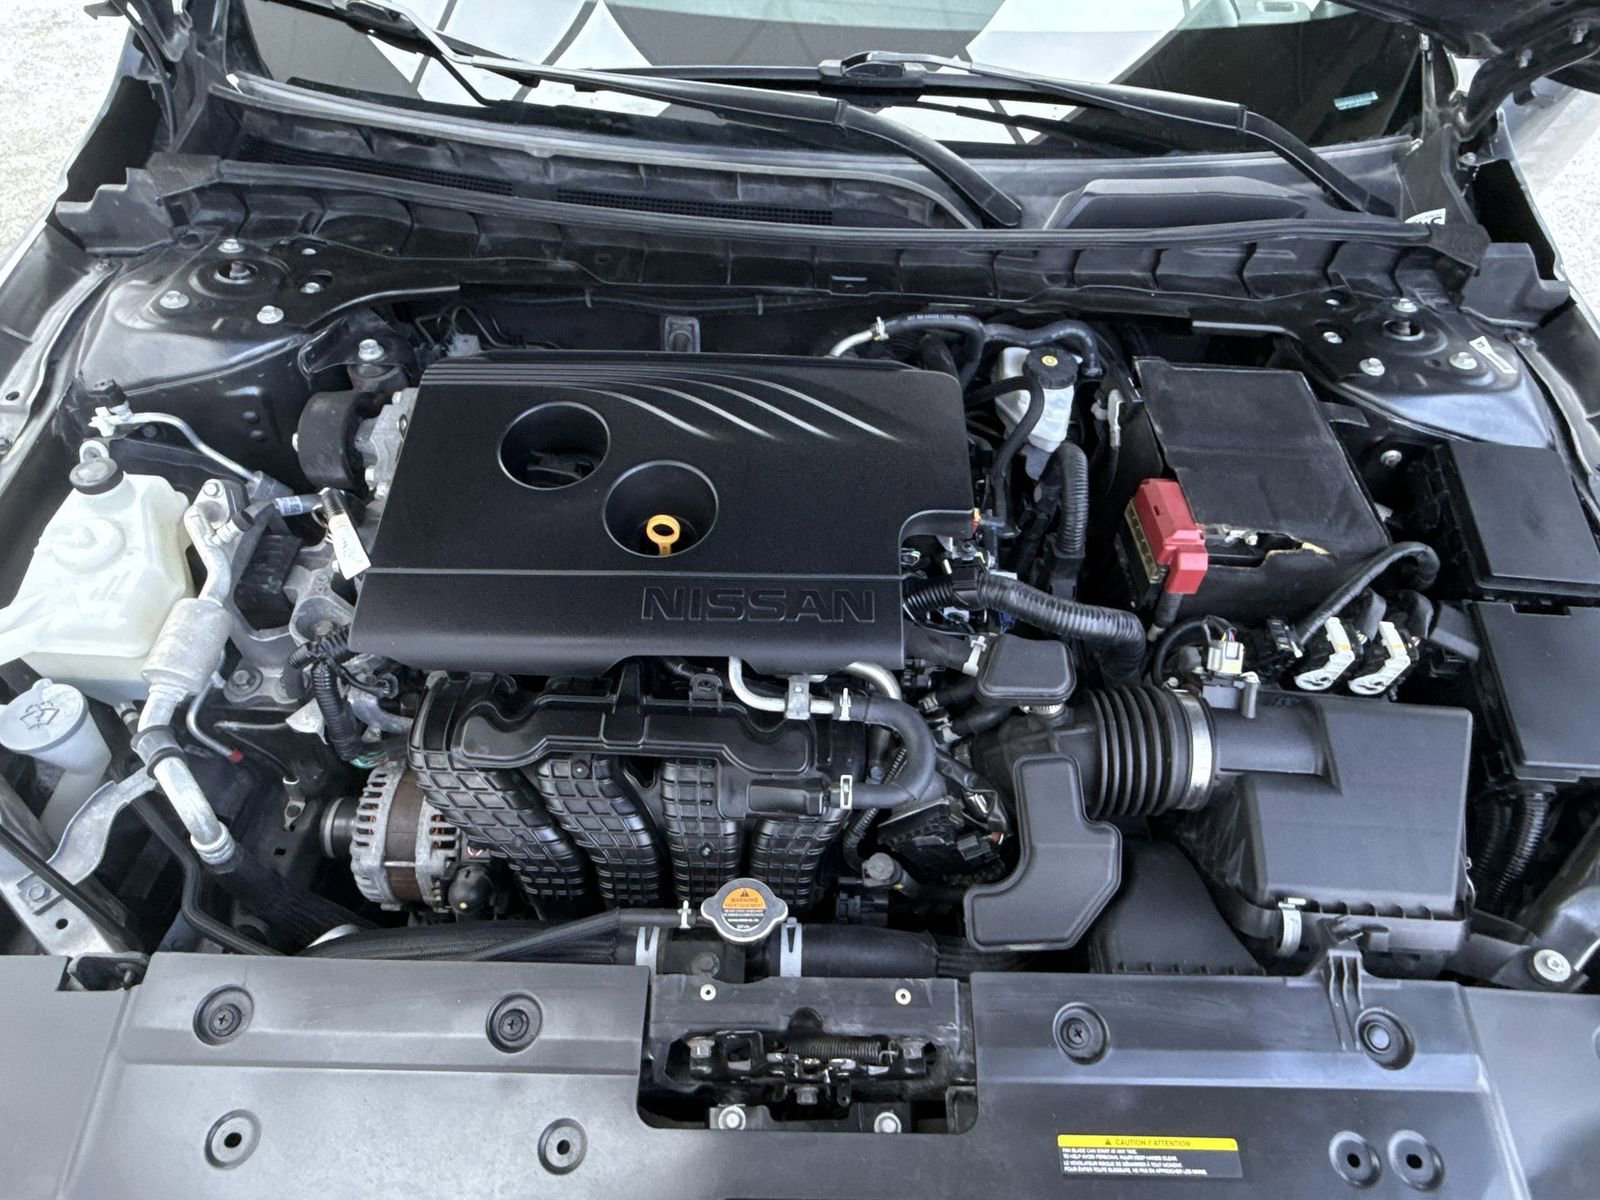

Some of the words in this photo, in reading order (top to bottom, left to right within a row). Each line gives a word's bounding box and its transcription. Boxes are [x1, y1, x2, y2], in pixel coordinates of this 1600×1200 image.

[641, 586, 876, 623] NISSAN
[1115, 1138, 1146, 1146] CAUTION
[1153, 1139, 1191, 1147] ATTENTION
